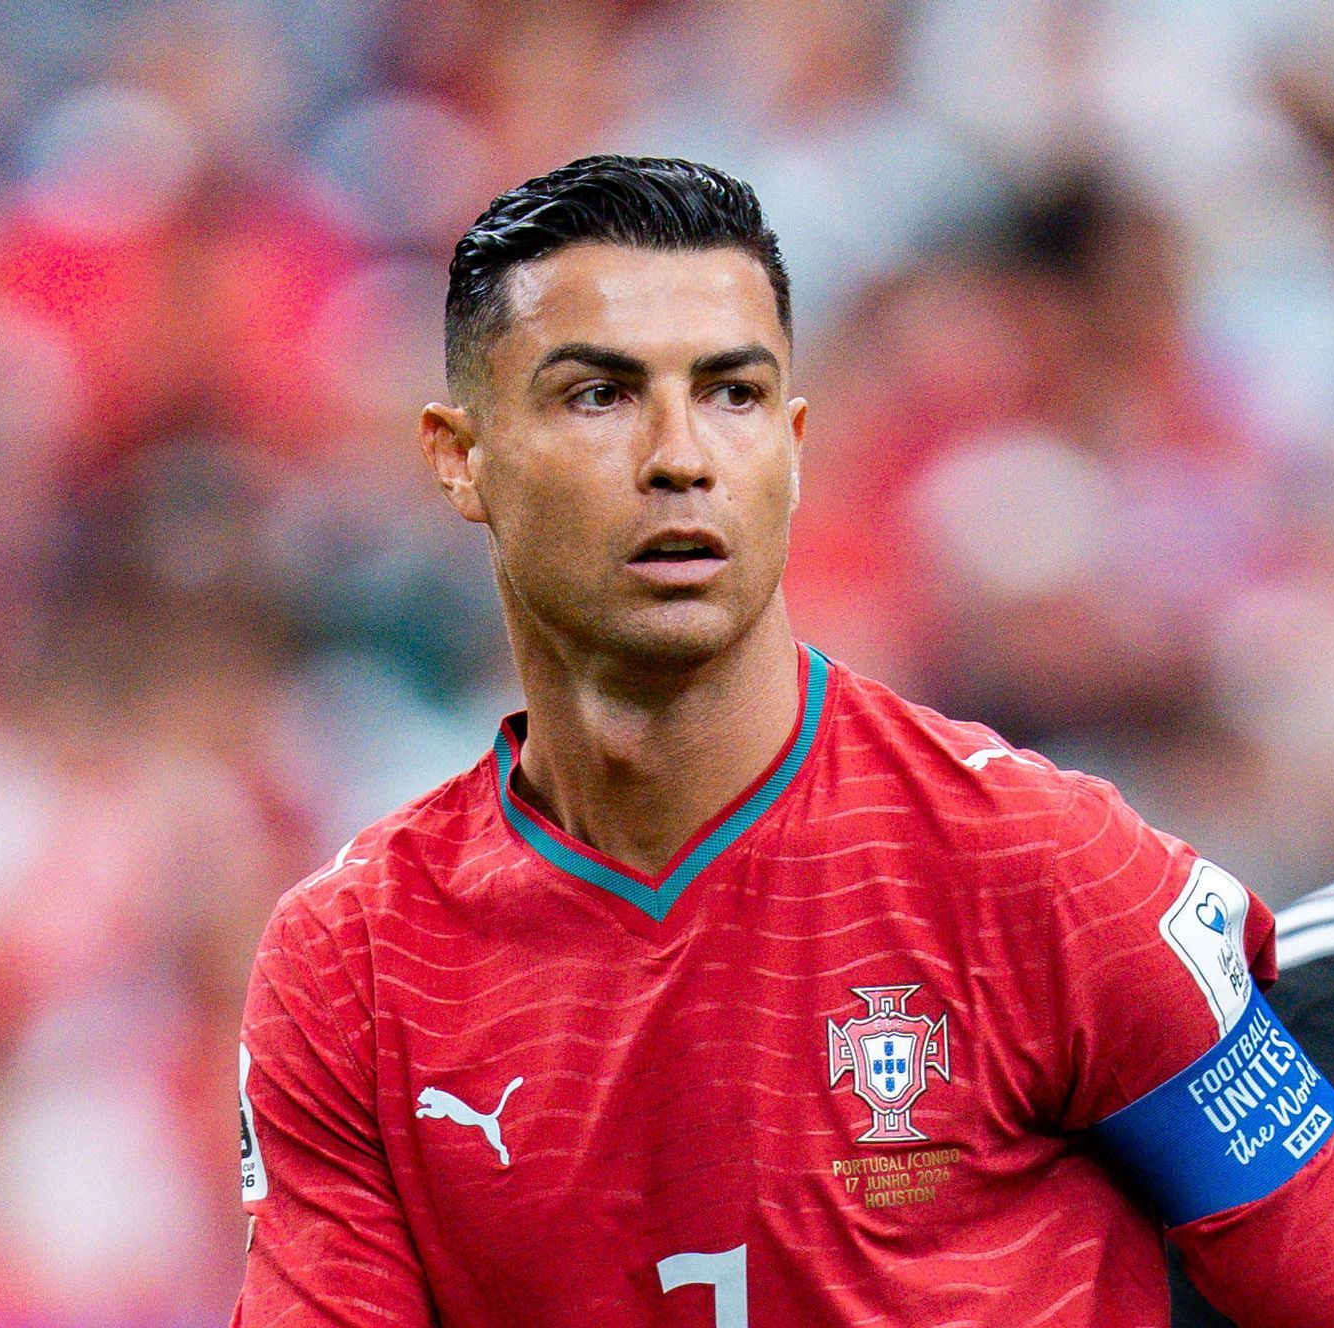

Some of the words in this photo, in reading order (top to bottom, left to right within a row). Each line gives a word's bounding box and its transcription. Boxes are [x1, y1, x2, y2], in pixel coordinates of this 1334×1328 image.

[1187, 1007, 1271, 1104] FOOTBALL
[1203, 1028, 1296, 1133] UNITES
[1225, 1124, 1275, 1165] the
[1265, 1053, 1321, 1127] World
[1288, 1111, 1329, 1151] FIFA
[845, 1177, 859, 1193] 17
[866, 1173, 910, 1190] JUNHO
[865, 1186, 935, 1208] HOUSTON
